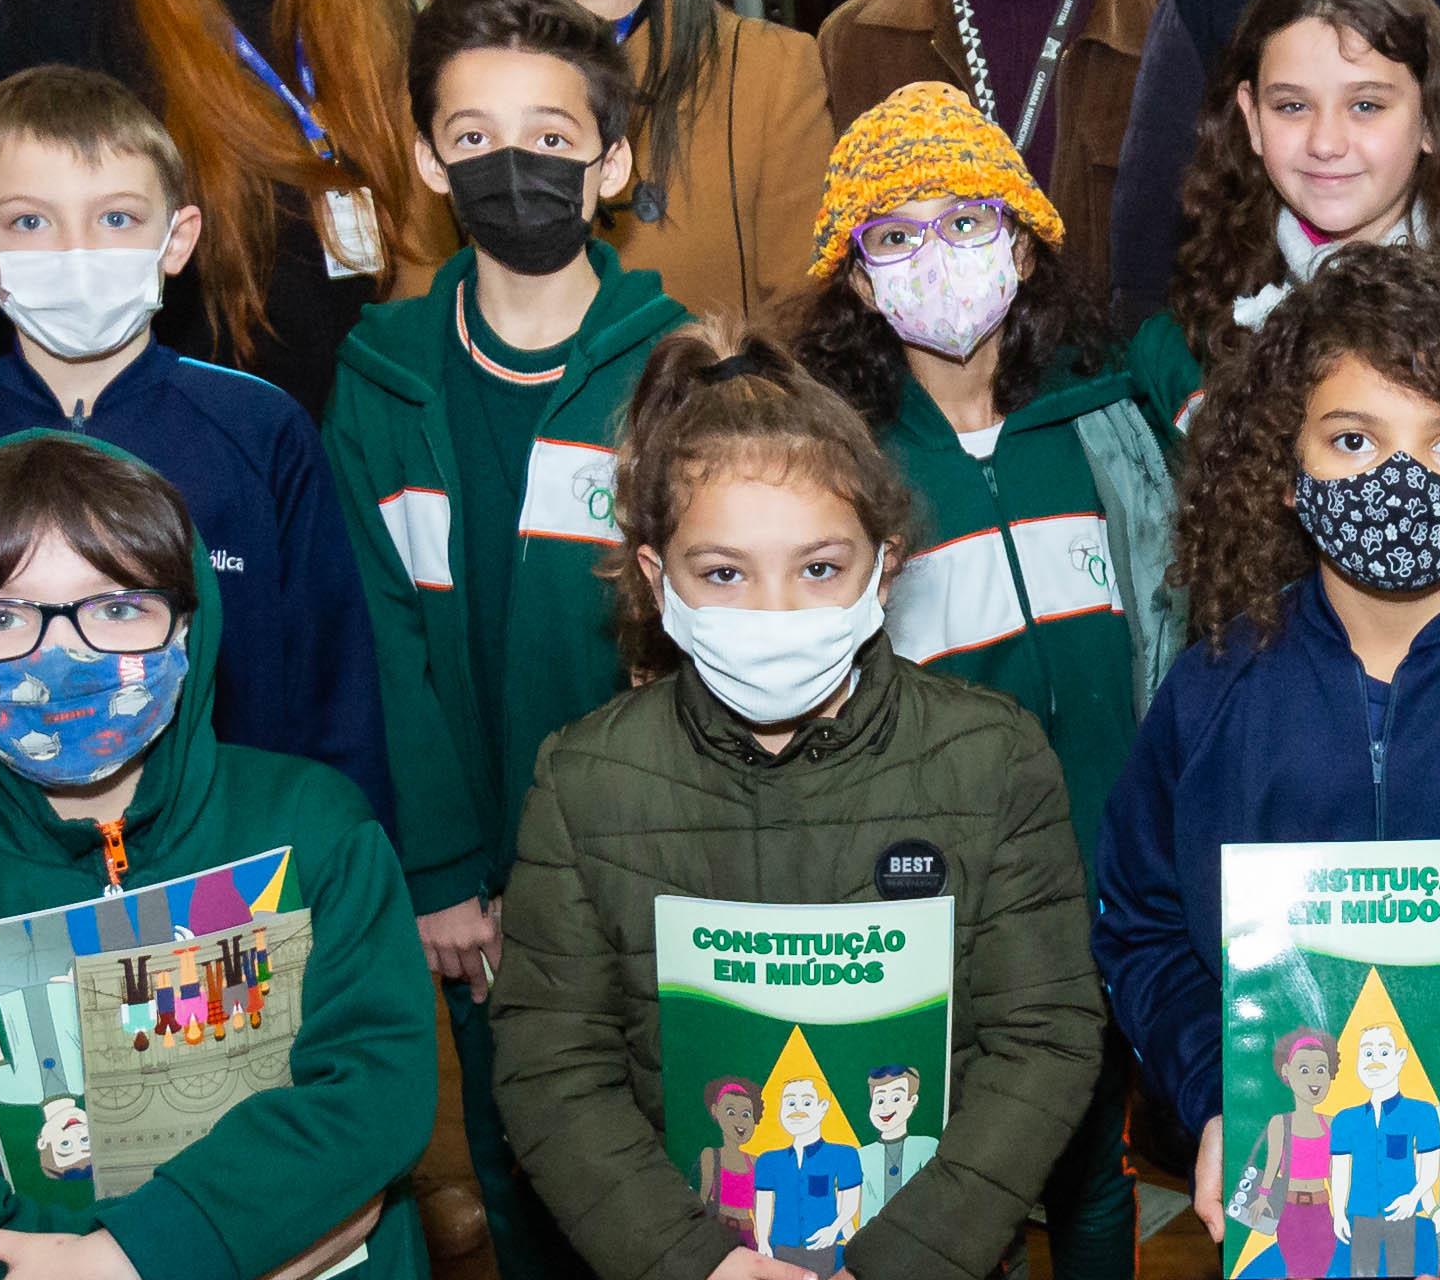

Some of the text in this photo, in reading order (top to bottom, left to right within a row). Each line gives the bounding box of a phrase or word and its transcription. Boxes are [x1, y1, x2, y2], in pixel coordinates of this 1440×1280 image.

[890, 856, 934, 873] BEST
[692, 925, 906, 960] CONSTITUIÇÃO
[713, 957, 885, 986] EM MIÚDOS
